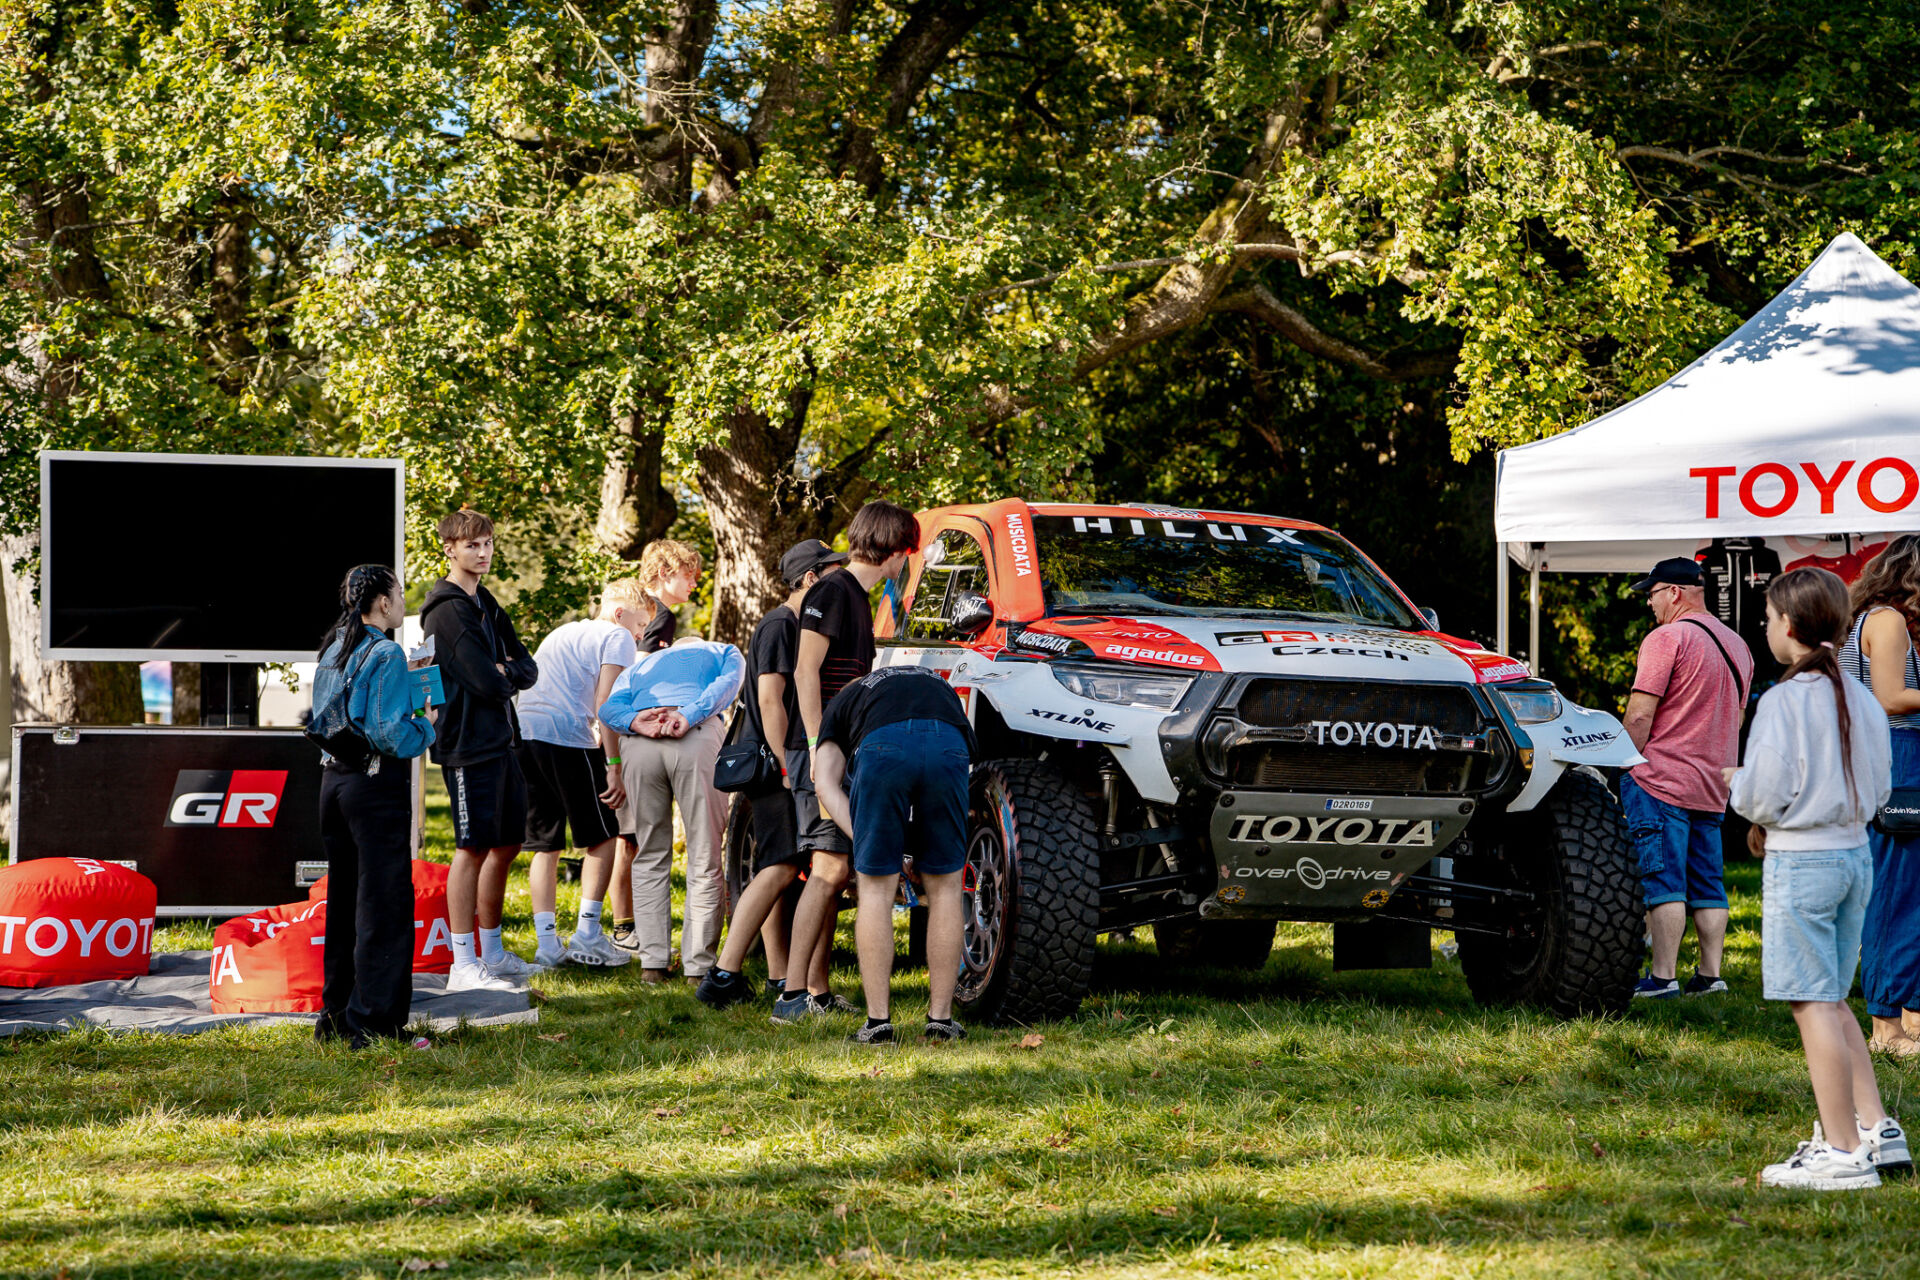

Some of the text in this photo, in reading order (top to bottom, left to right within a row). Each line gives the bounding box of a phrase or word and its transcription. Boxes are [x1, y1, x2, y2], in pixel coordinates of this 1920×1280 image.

[1690, 457, 1919, 519] TOYO
[1072, 517, 1305, 546] HILUX
[1005, 513, 1032, 577] MUSICDATA
[1015, 630, 1073, 653] MUSICDATA
[1219, 631, 1317, 646] GR
[1105, 644, 1205, 666] agados
[1272, 645, 1409, 662] Czech
[1479, 662, 1528, 681] agados
[1026, 708, 1116, 734] XTLINE
[1311, 720, 1437, 750] TOYOTA
[1560, 731, 1617, 748] XTLINE
[170, 792, 278, 824] GR
[1884, 806, 1906, 814] Calvin
[1234, 815, 1433, 846] TOYOTA
[0, 915, 155, 958] TOYOT
